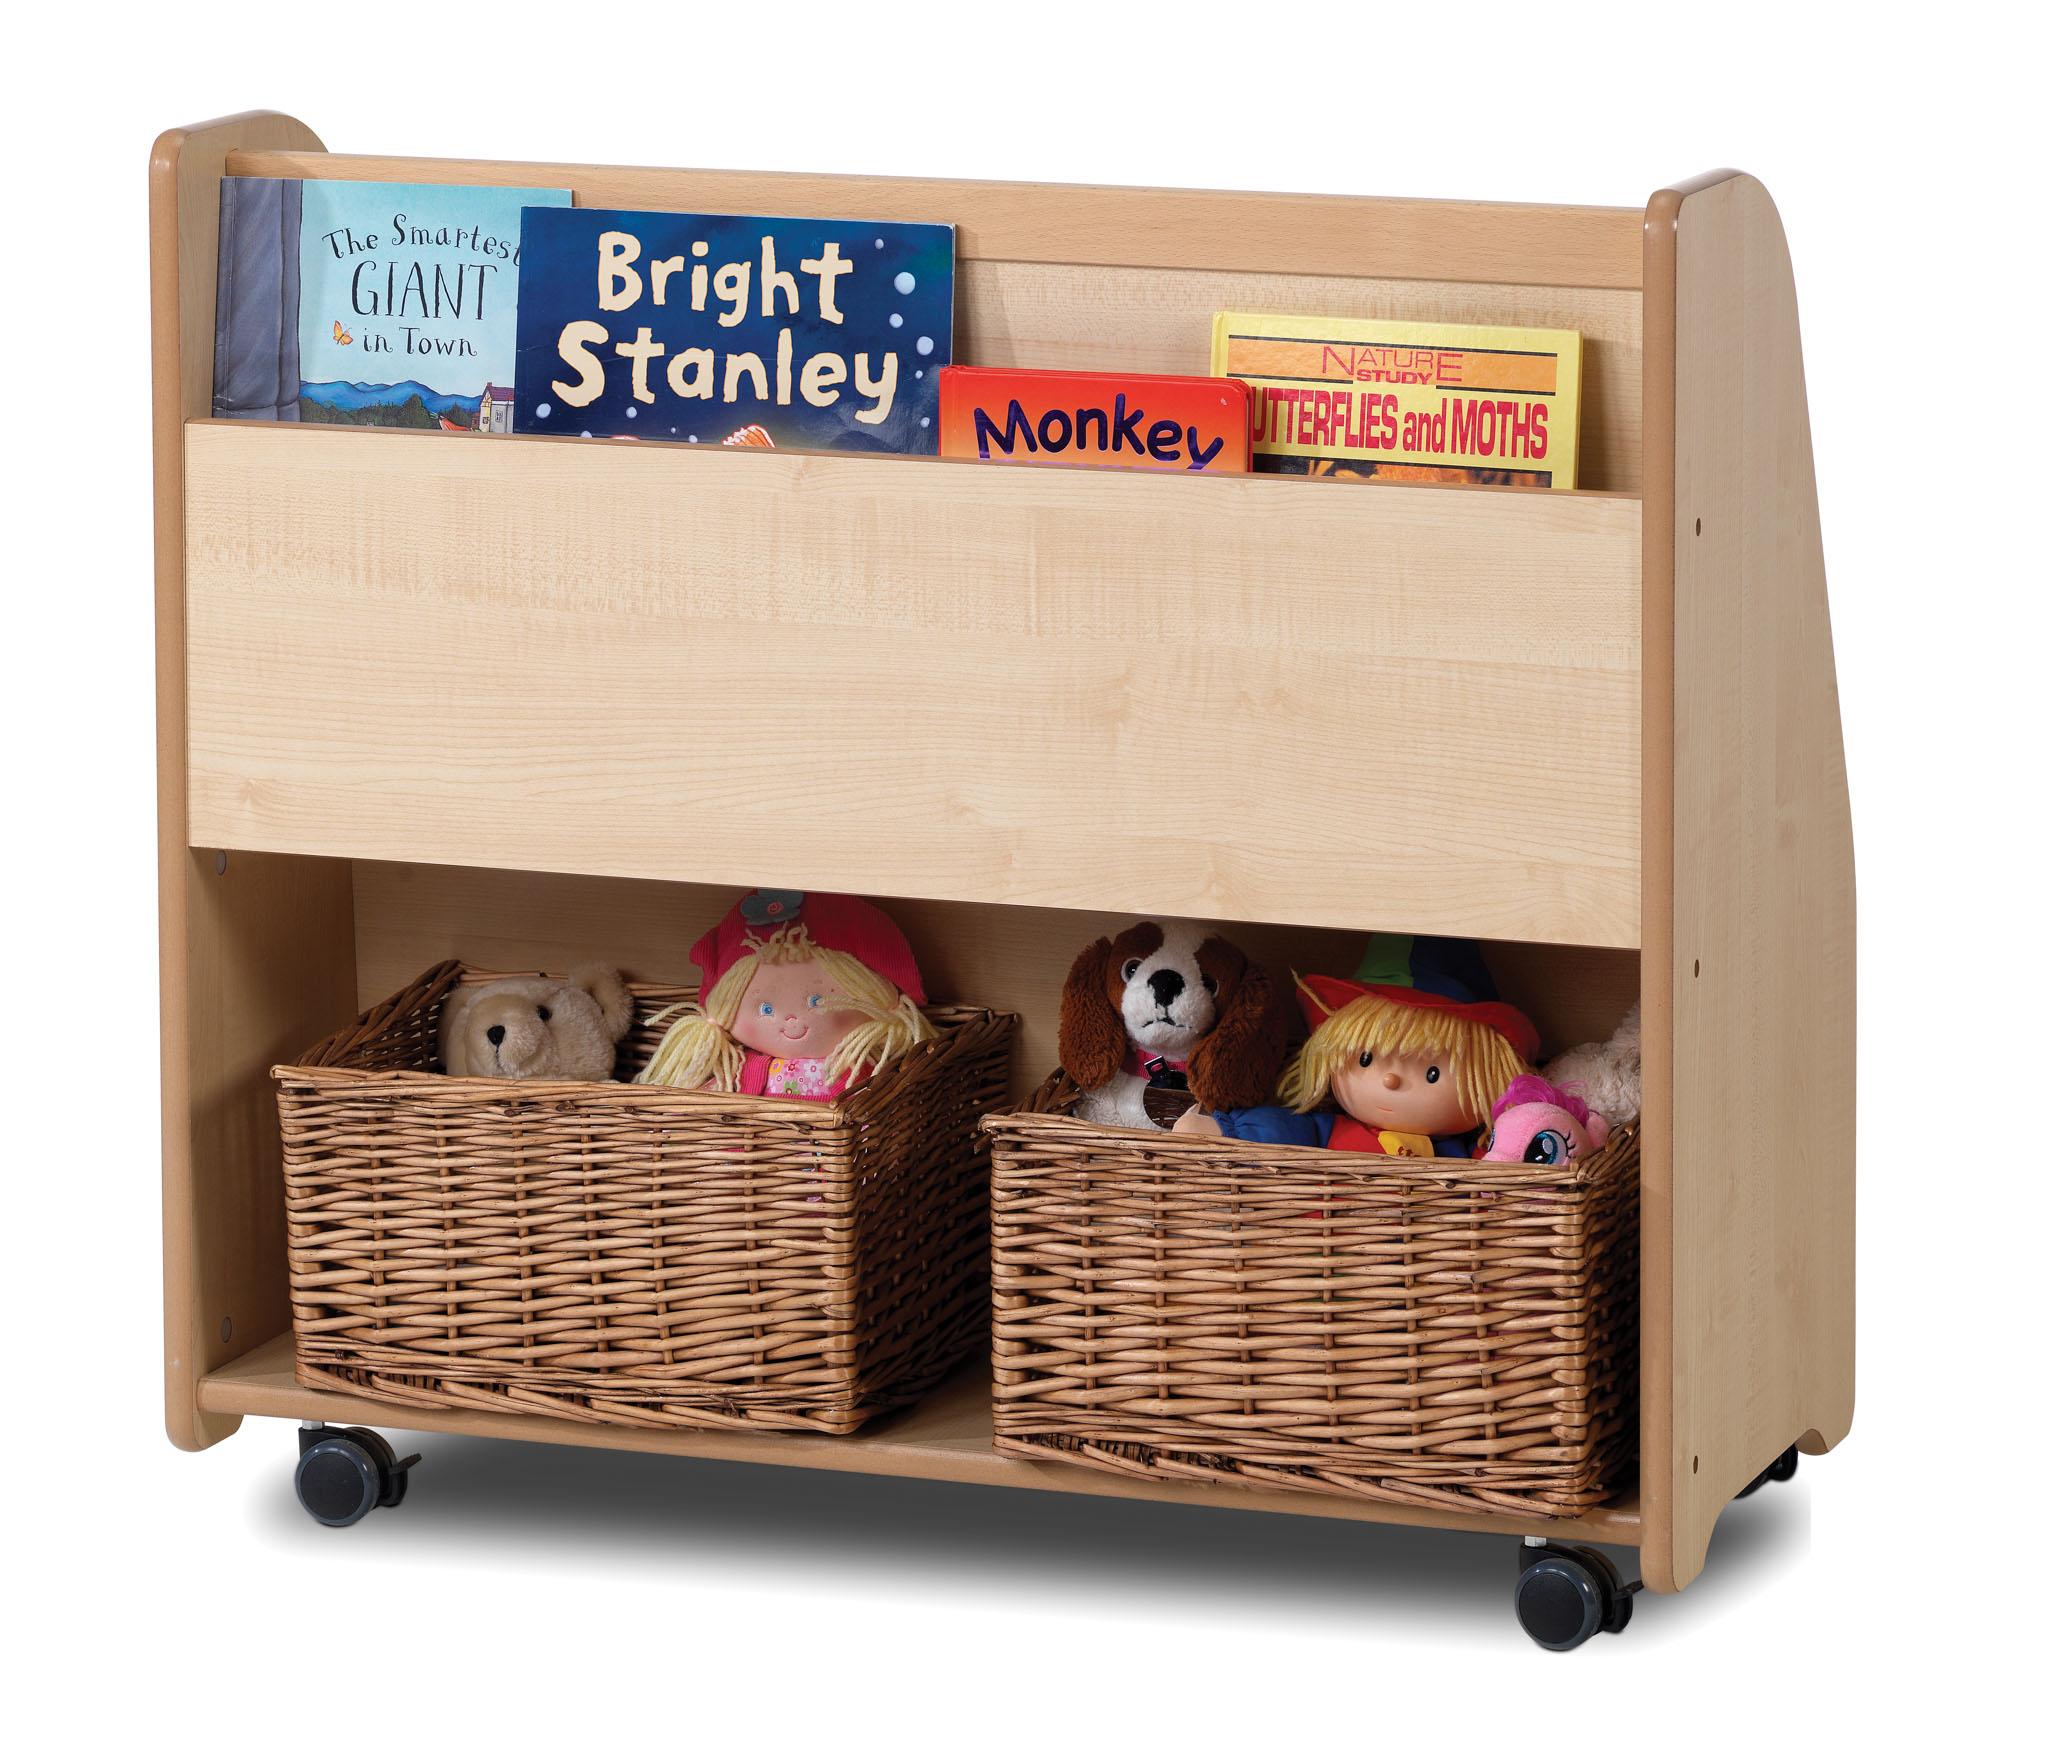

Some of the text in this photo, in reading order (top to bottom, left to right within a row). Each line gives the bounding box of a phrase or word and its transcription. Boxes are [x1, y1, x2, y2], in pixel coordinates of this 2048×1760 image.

[321, 227, 379, 259] The
[351, 260, 498, 321] GIANT
[598, 231, 853, 328] Bright
[363, 327, 478, 357] in Town
[551, 320, 898, 425] Stanley
[1322, 345, 1464, 382] NATURE
[1356, 369, 1433, 385] STUDY
[973, 392, 1224, 470] Monkey
[1251, 386, 1549, 460] UTTERFLIES and MOTHS
